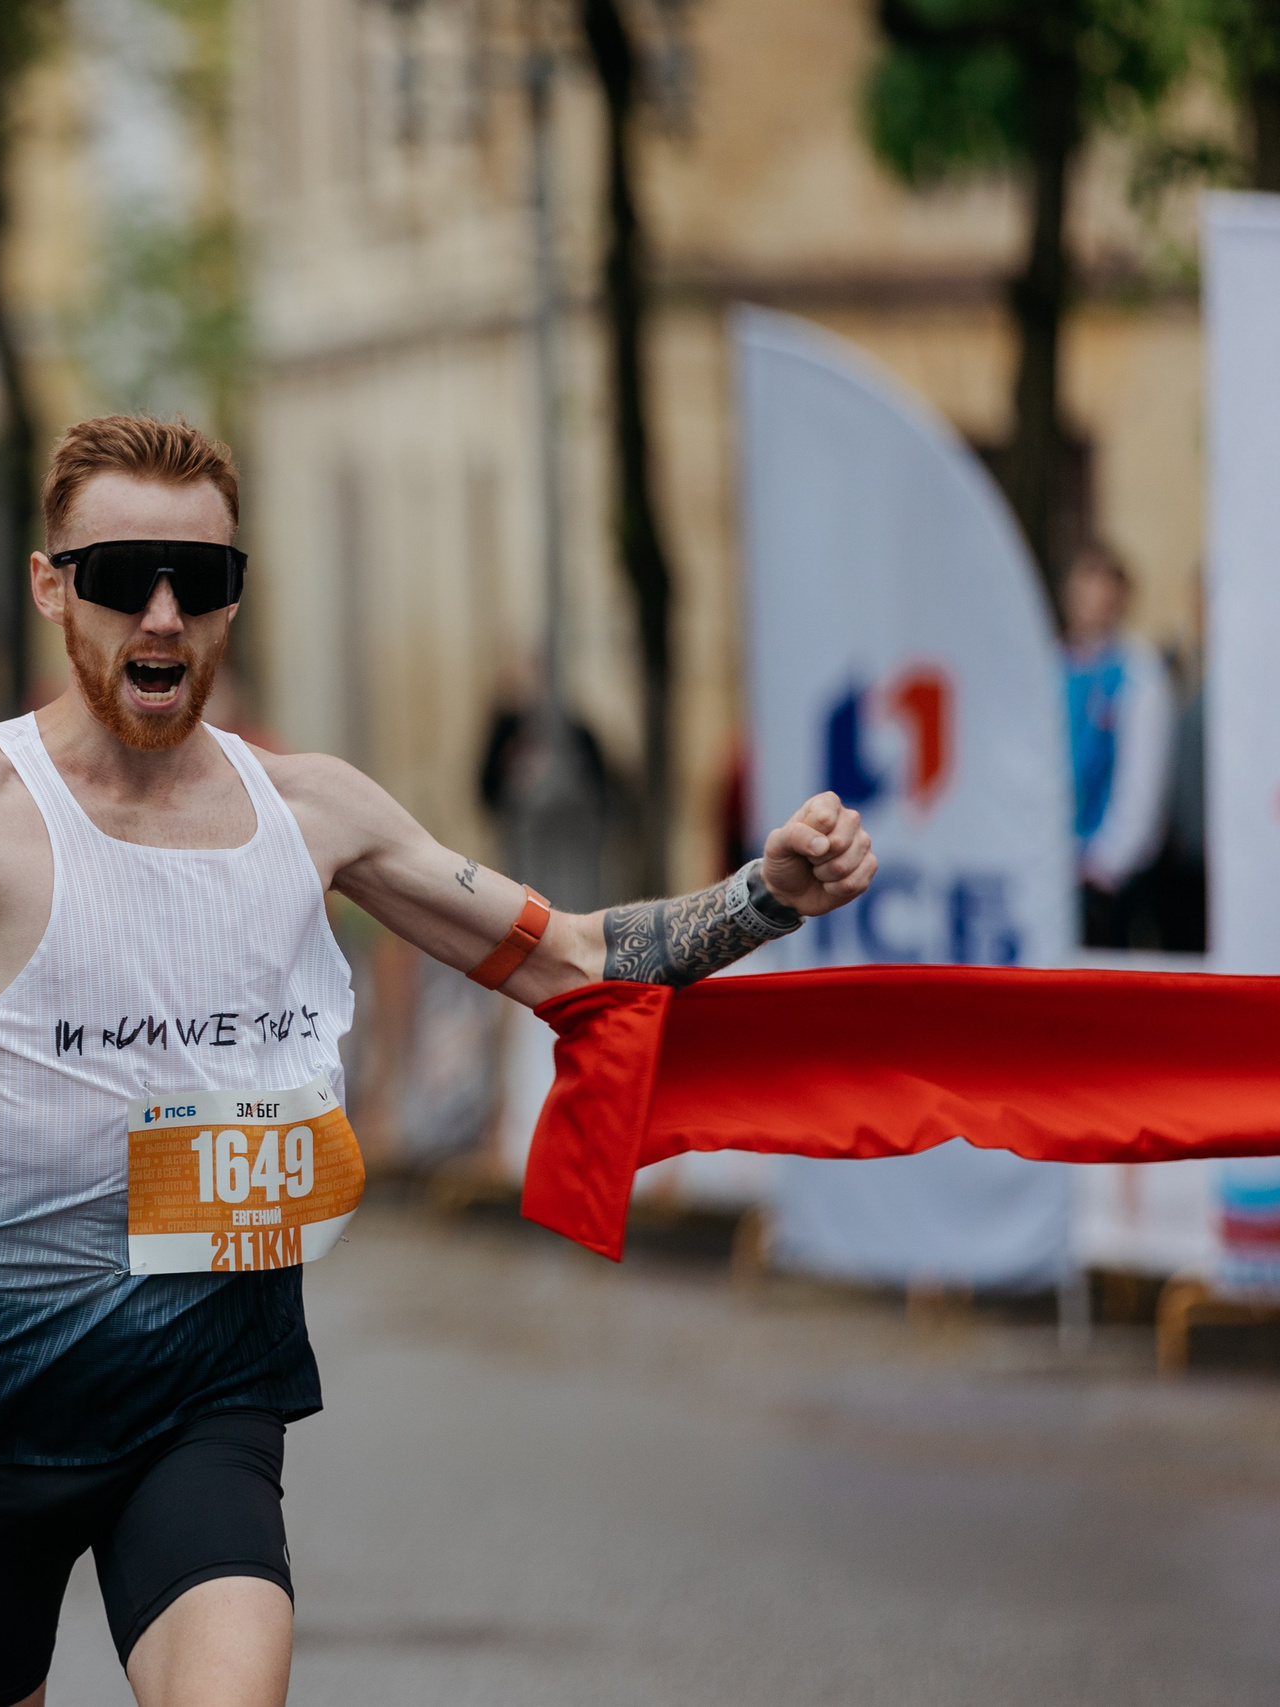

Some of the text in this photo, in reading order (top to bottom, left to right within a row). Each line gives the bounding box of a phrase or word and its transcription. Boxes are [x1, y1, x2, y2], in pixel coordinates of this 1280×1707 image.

[103, 1015, 167, 1051] RUN
[175, 1012, 240, 1048] WE
[165, 1105, 197, 1119] ПСБ
[145, 1141, 180, 1154] ВЫБЕГАЮ
[162, 1155, 173, 1165] НА
[191, 1126, 314, 1204] 1649
[143, 1169, 157, 1180] БЕГ
[157, 1168, 162, 1179] В
[163, 1167, 181, 1178] СЕБЕ
[139, 1182, 163, 1195] ДАВНО
[164, 1180, 193, 1191] ОТСТАЛ
[153, 1195, 183, 1206] ТОЛЬКО
[159, 1208, 182, 1219] ЛЮБИ
[183, 1207, 196, 1218] БЕГ
[197, 1207, 203, 1218] В
[204, 1207, 222, 1218] СЕБЕ
[232, 1205, 282, 1226] ЕВГЕНИЙ
[167, 1221, 196, 1232] СТРЕСС
[197, 1220, 222, 1232] ДАВНО
